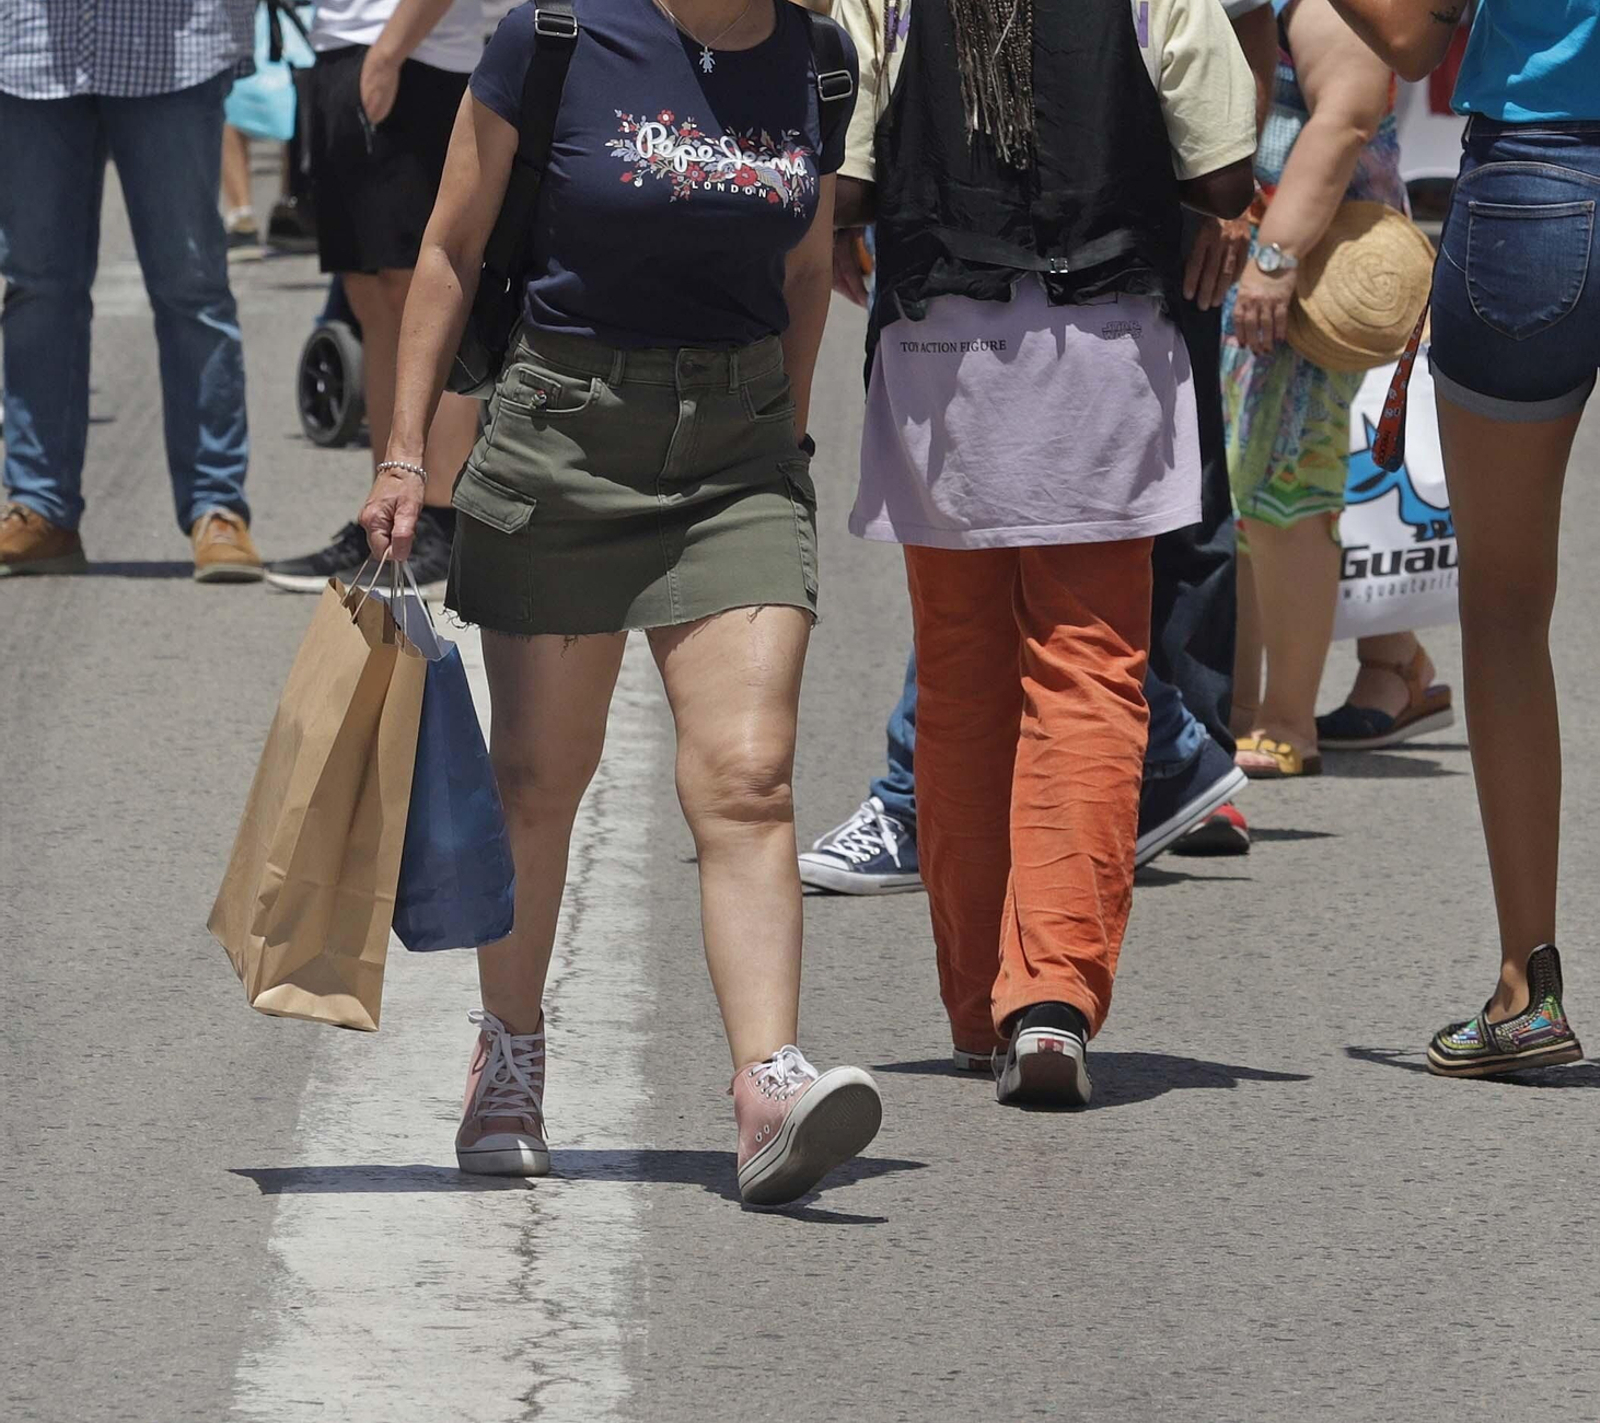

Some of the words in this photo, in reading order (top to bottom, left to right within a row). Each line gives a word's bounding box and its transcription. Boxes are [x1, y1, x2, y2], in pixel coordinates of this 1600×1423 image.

[636, 121, 716, 173] Pepe
[717, 135, 807, 177] Jeans
[692, 181, 767, 199] LONDON
[920, 341, 958, 354] ACTION
[960, 339, 1008, 354] FIGURE
